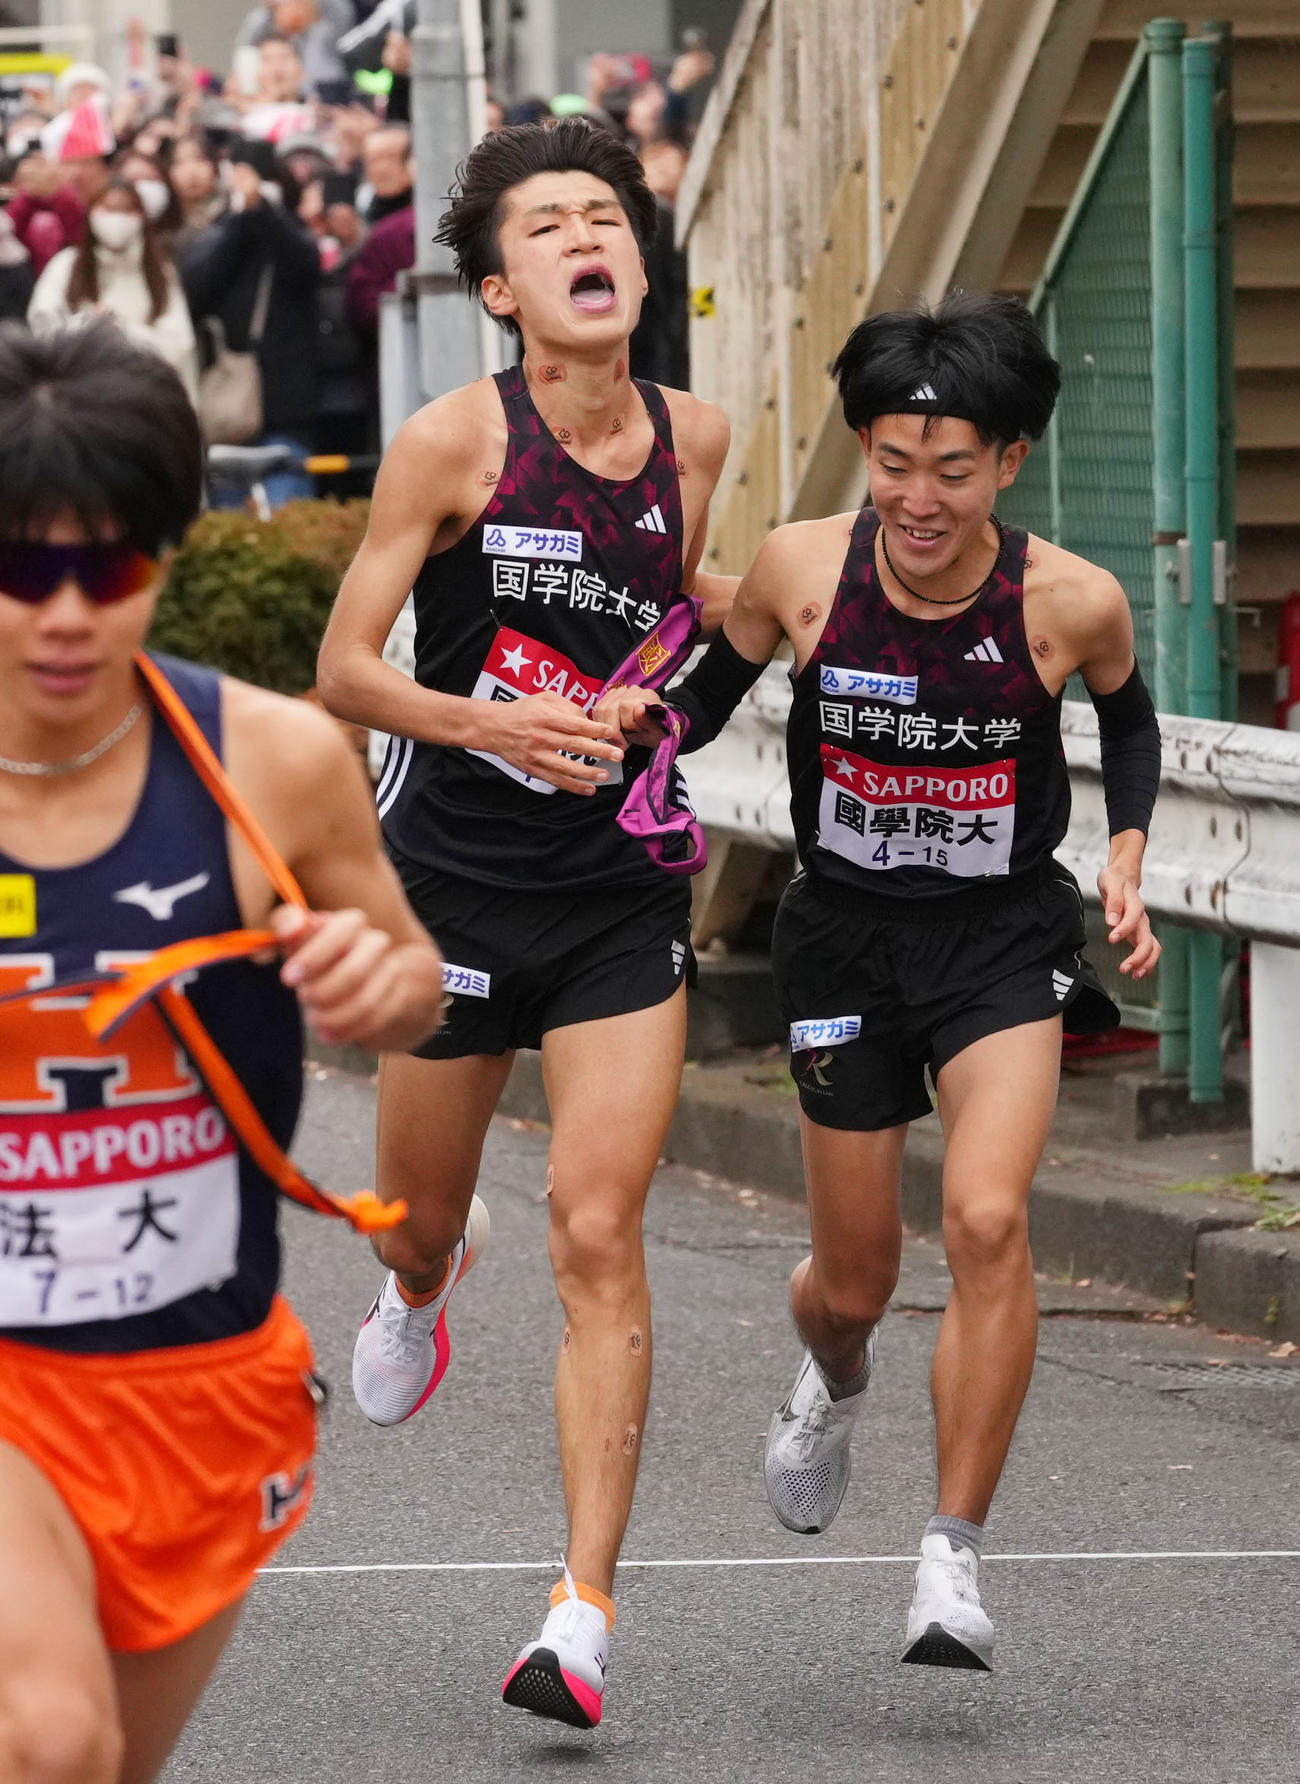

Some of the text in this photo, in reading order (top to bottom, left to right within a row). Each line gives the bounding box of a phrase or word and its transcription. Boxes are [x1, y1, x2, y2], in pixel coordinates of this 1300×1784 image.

[515, 532, 579, 554] アサガミ
[847, 675, 916, 697] アサガミ
[819, 700, 1022, 751] 国学院大学
[863, 771, 1009, 802] SAPPORO
[834, 790, 998, 847] 國學院大
[797, 1020, 859, 1042] アサガミ
[0, 1106, 226, 1181] SAPPORO
